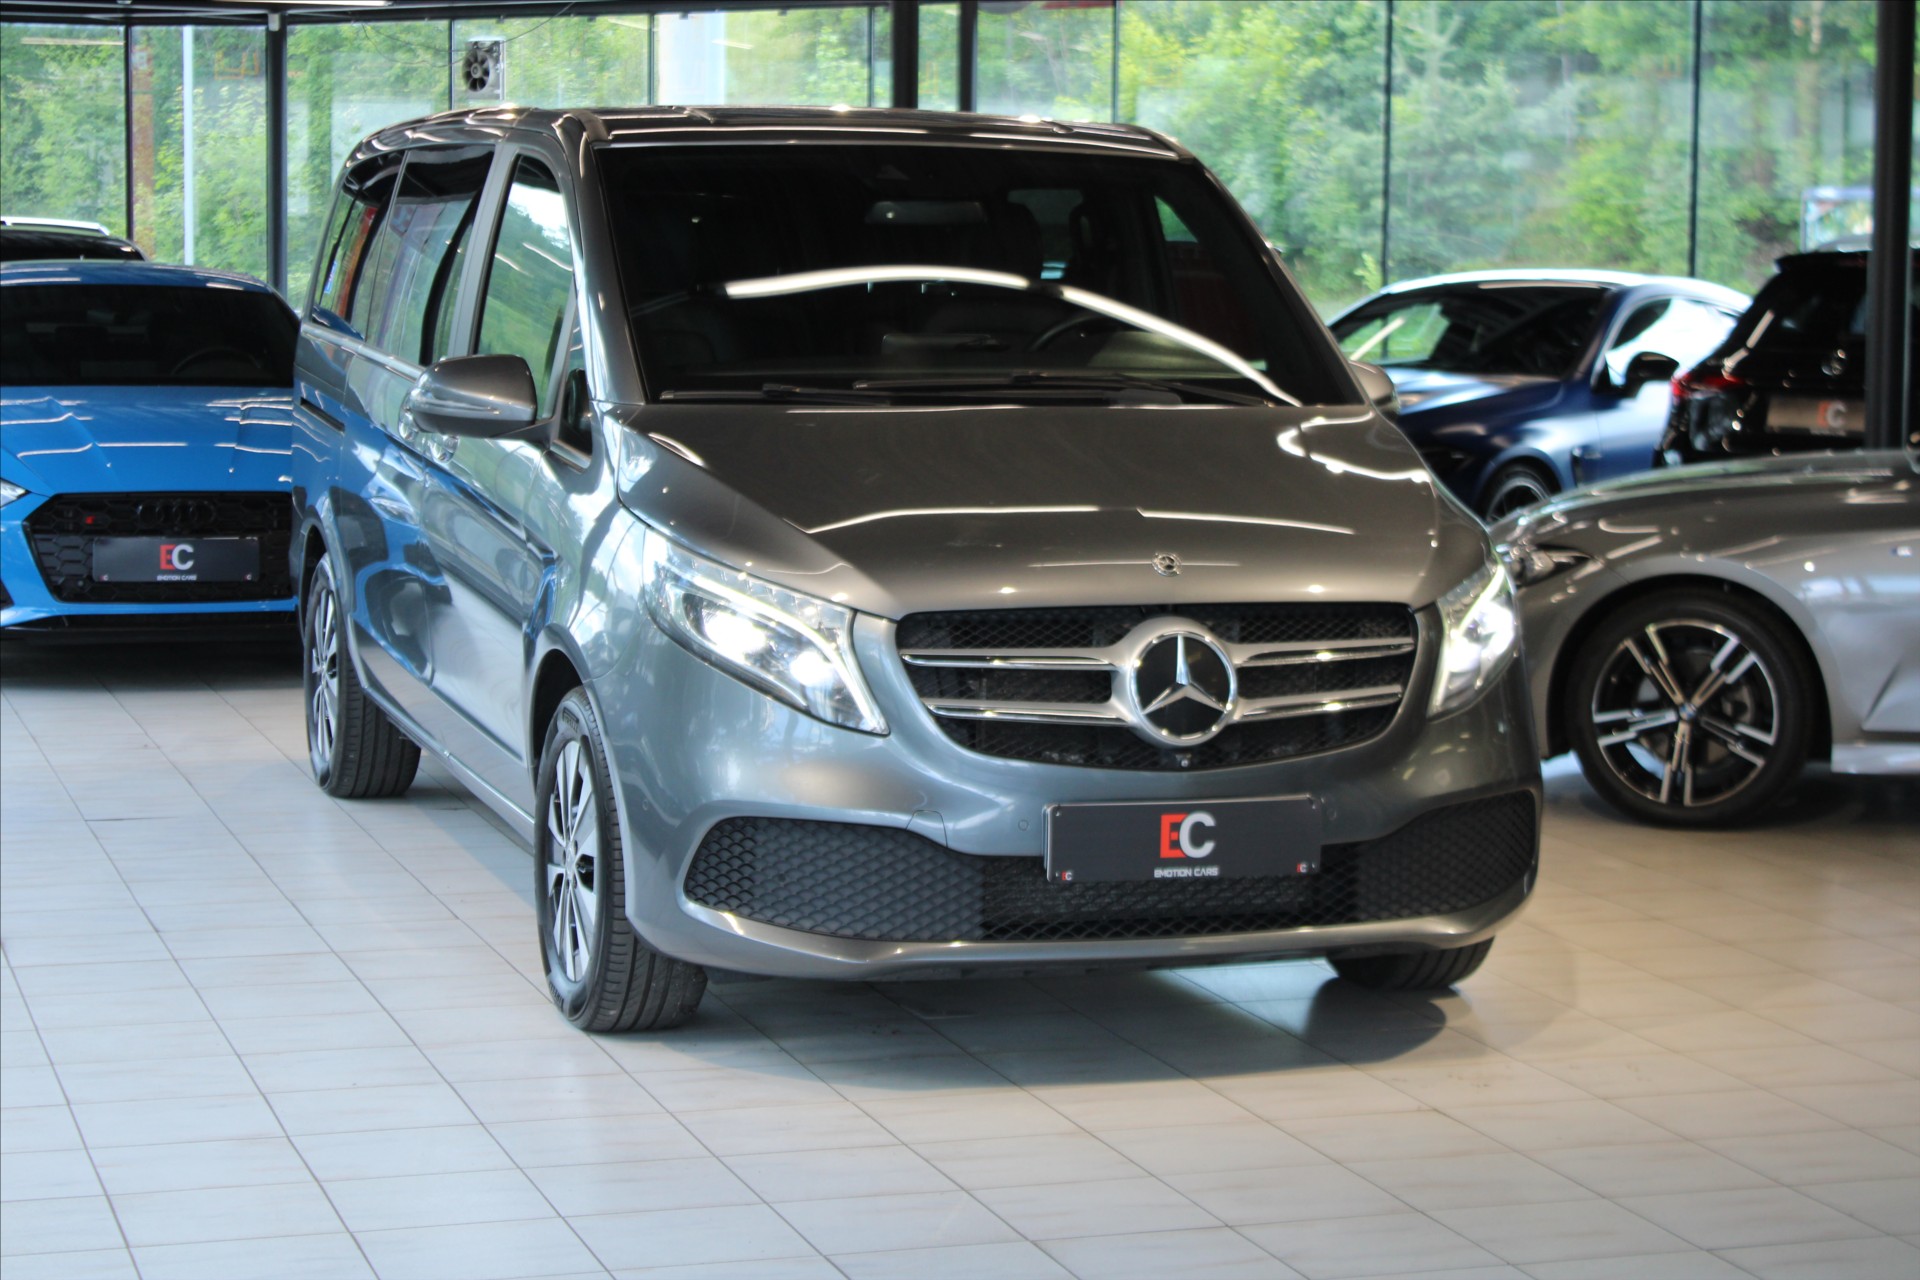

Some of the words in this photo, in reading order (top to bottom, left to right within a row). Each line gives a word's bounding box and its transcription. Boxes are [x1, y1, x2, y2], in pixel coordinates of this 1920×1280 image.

[160, 543, 194, 570] EC
[1160, 811, 1216, 859] EC
[1154, 868, 1192, 878] EMOTION
[1193, 866, 1219, 877] CARS
